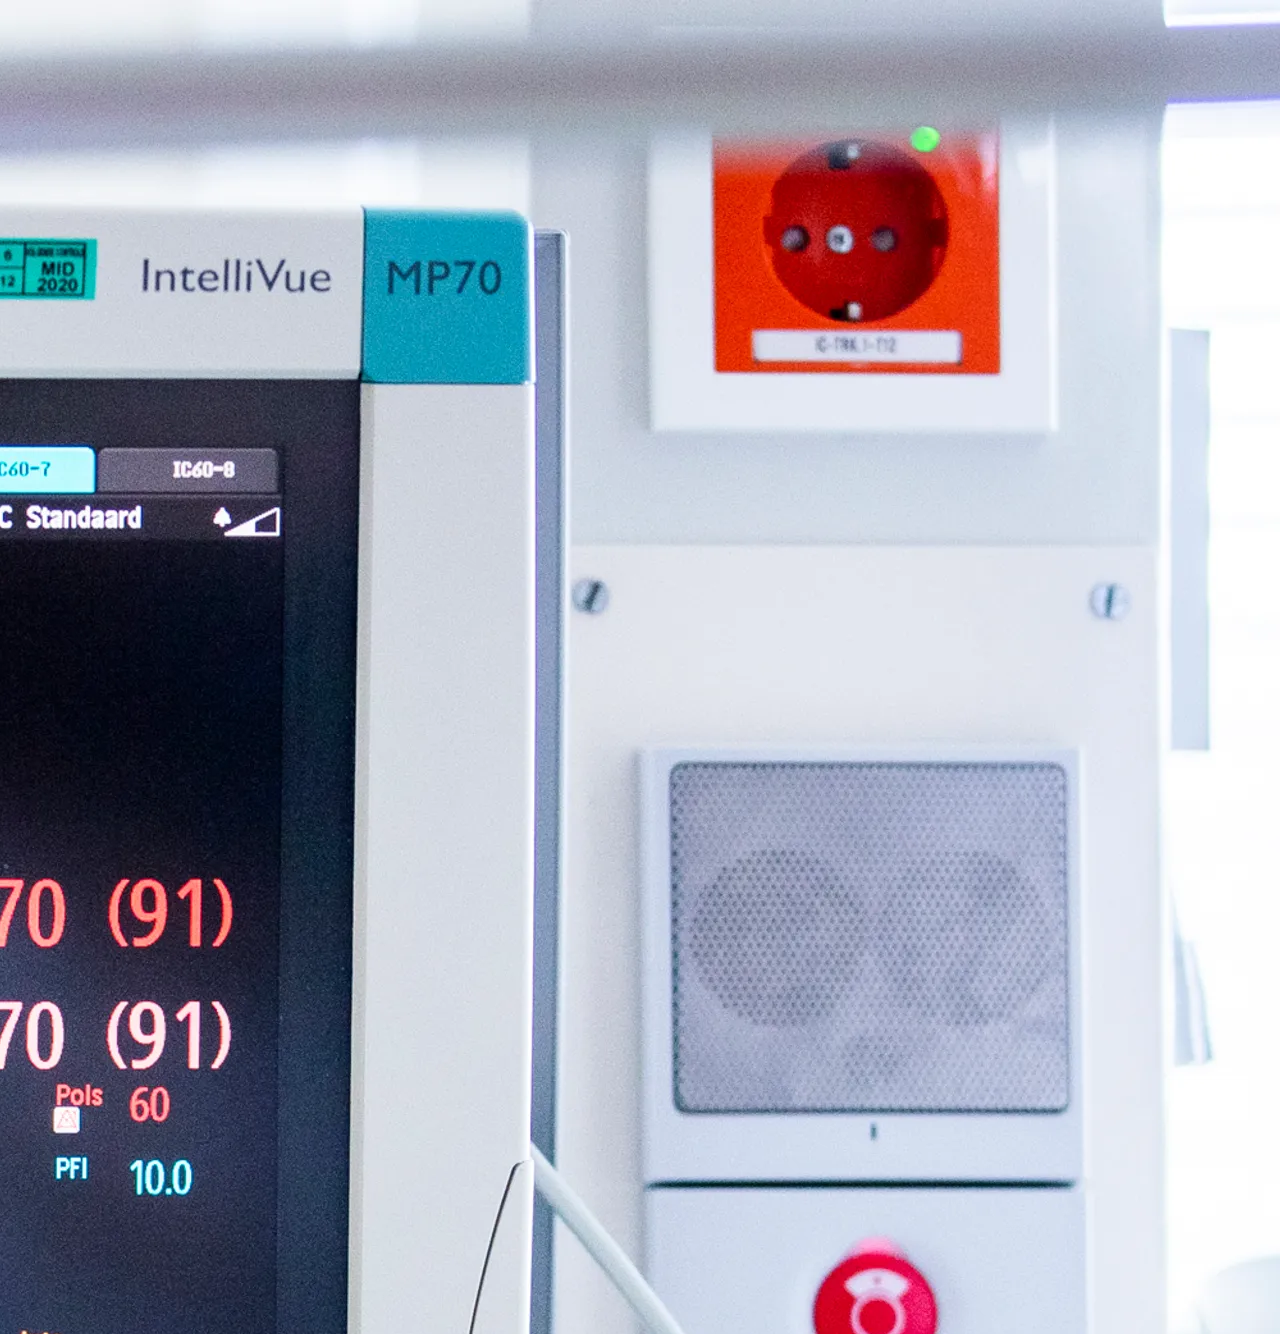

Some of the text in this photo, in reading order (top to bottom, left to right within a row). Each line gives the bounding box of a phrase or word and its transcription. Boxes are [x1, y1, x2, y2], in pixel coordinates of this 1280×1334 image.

[0, 274, 16, 288] 12
[37, 277, 79, 293] 2020
[41, 260, 75, 276] MID
[141, 258, 332, 294] IntelliVue
[386, 260, 502, 296] MP70
[172, 460, 235, 479] IC60-8
[25, 505, 142, 531] Standaard
[108, 877, 234, 949] (91)
[106, 999, 232, 1072] (91)
[56, 1084, 171, 1123] Pols 60
[55, 1157, 193, 1196] PFI 10.0
